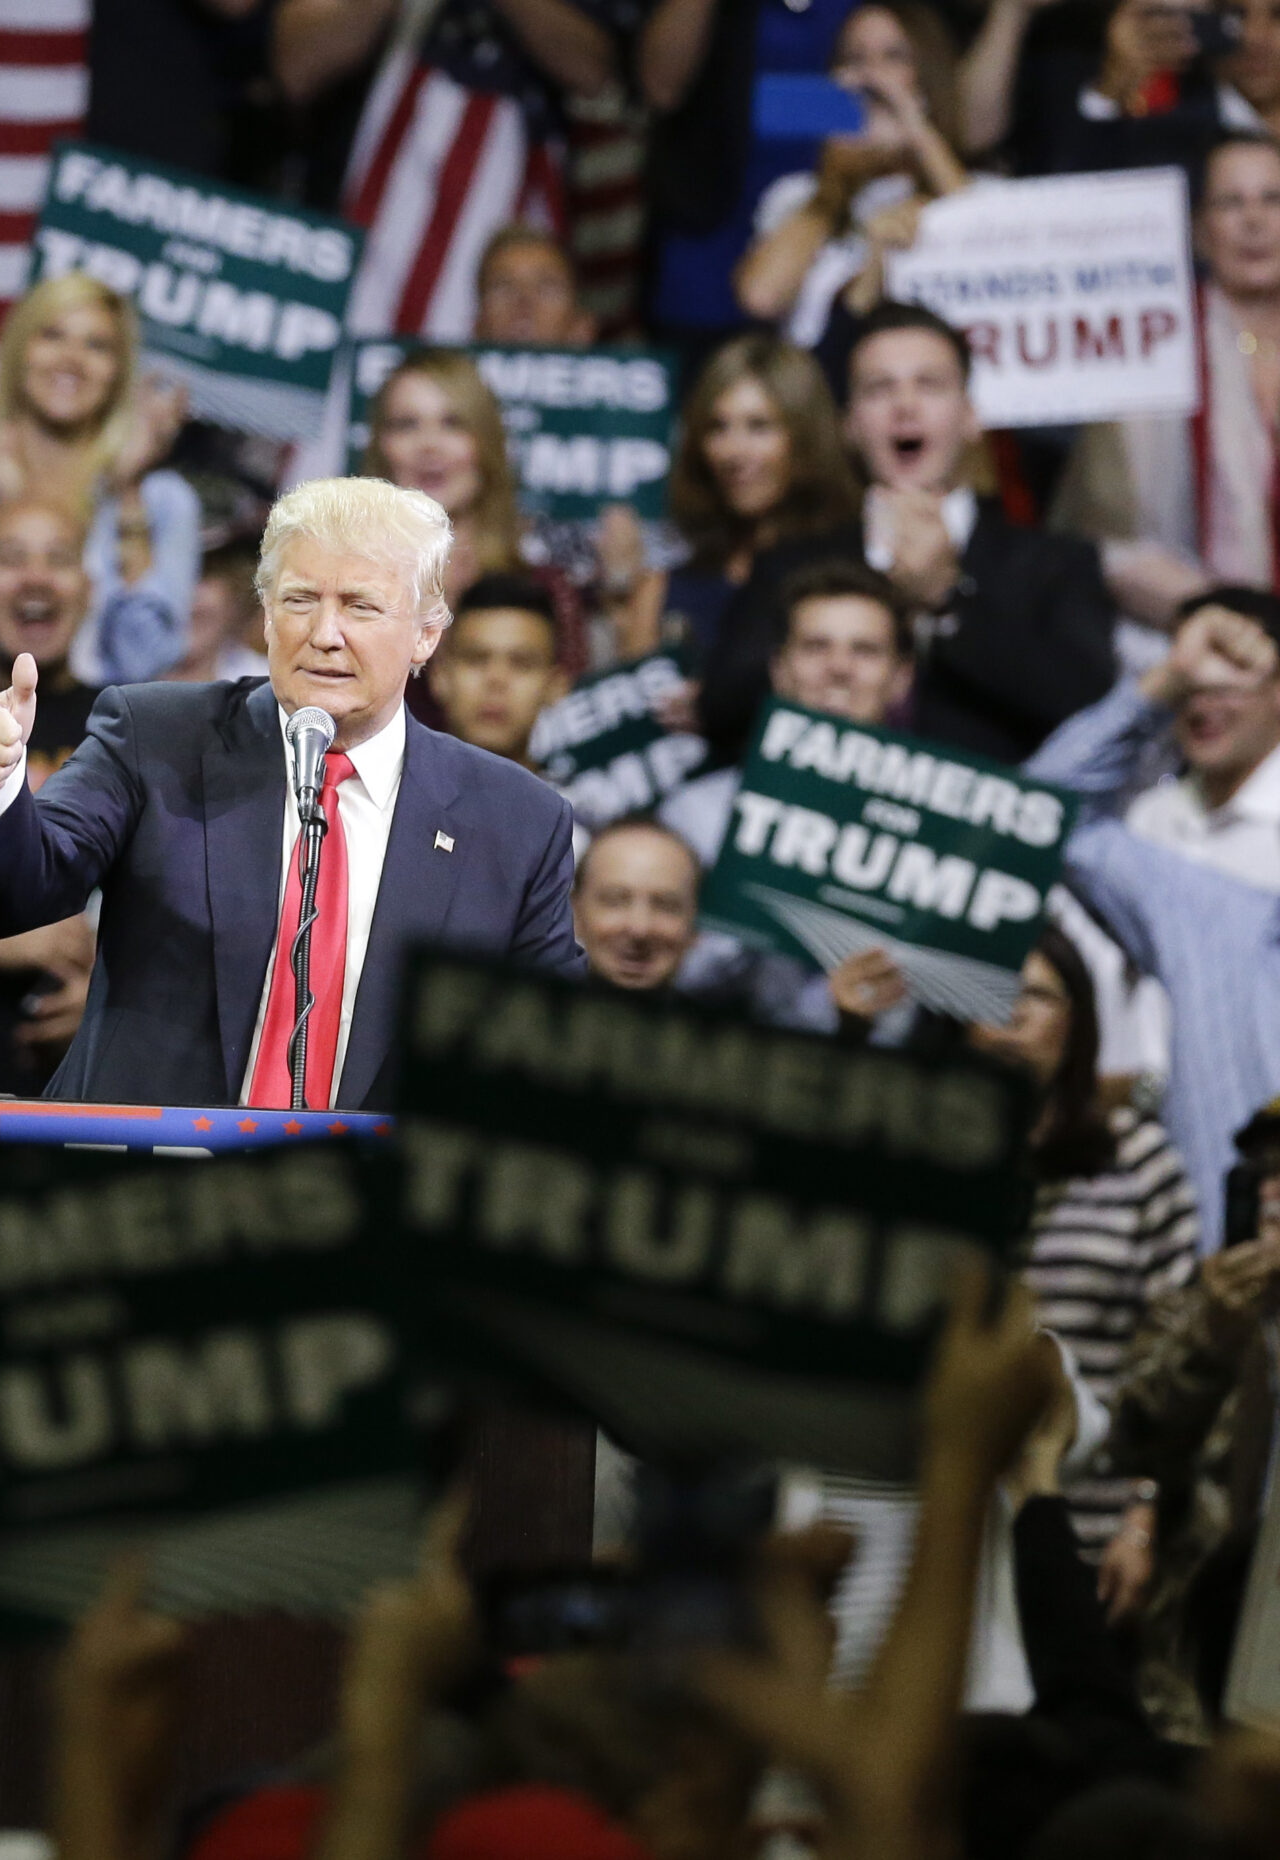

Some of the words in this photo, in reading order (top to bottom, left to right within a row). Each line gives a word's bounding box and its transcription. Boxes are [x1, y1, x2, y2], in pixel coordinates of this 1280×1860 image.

[53, 150, 354, 283] FARMERS
[356, 344, 668, 413] FMERS
[964, 309, 1177, 370] RUMP
[527, 657, 687, 763] MERS
[760, 708, 1065, 850] FARMERS
[733, 790, 1041, 933] TRUMP
